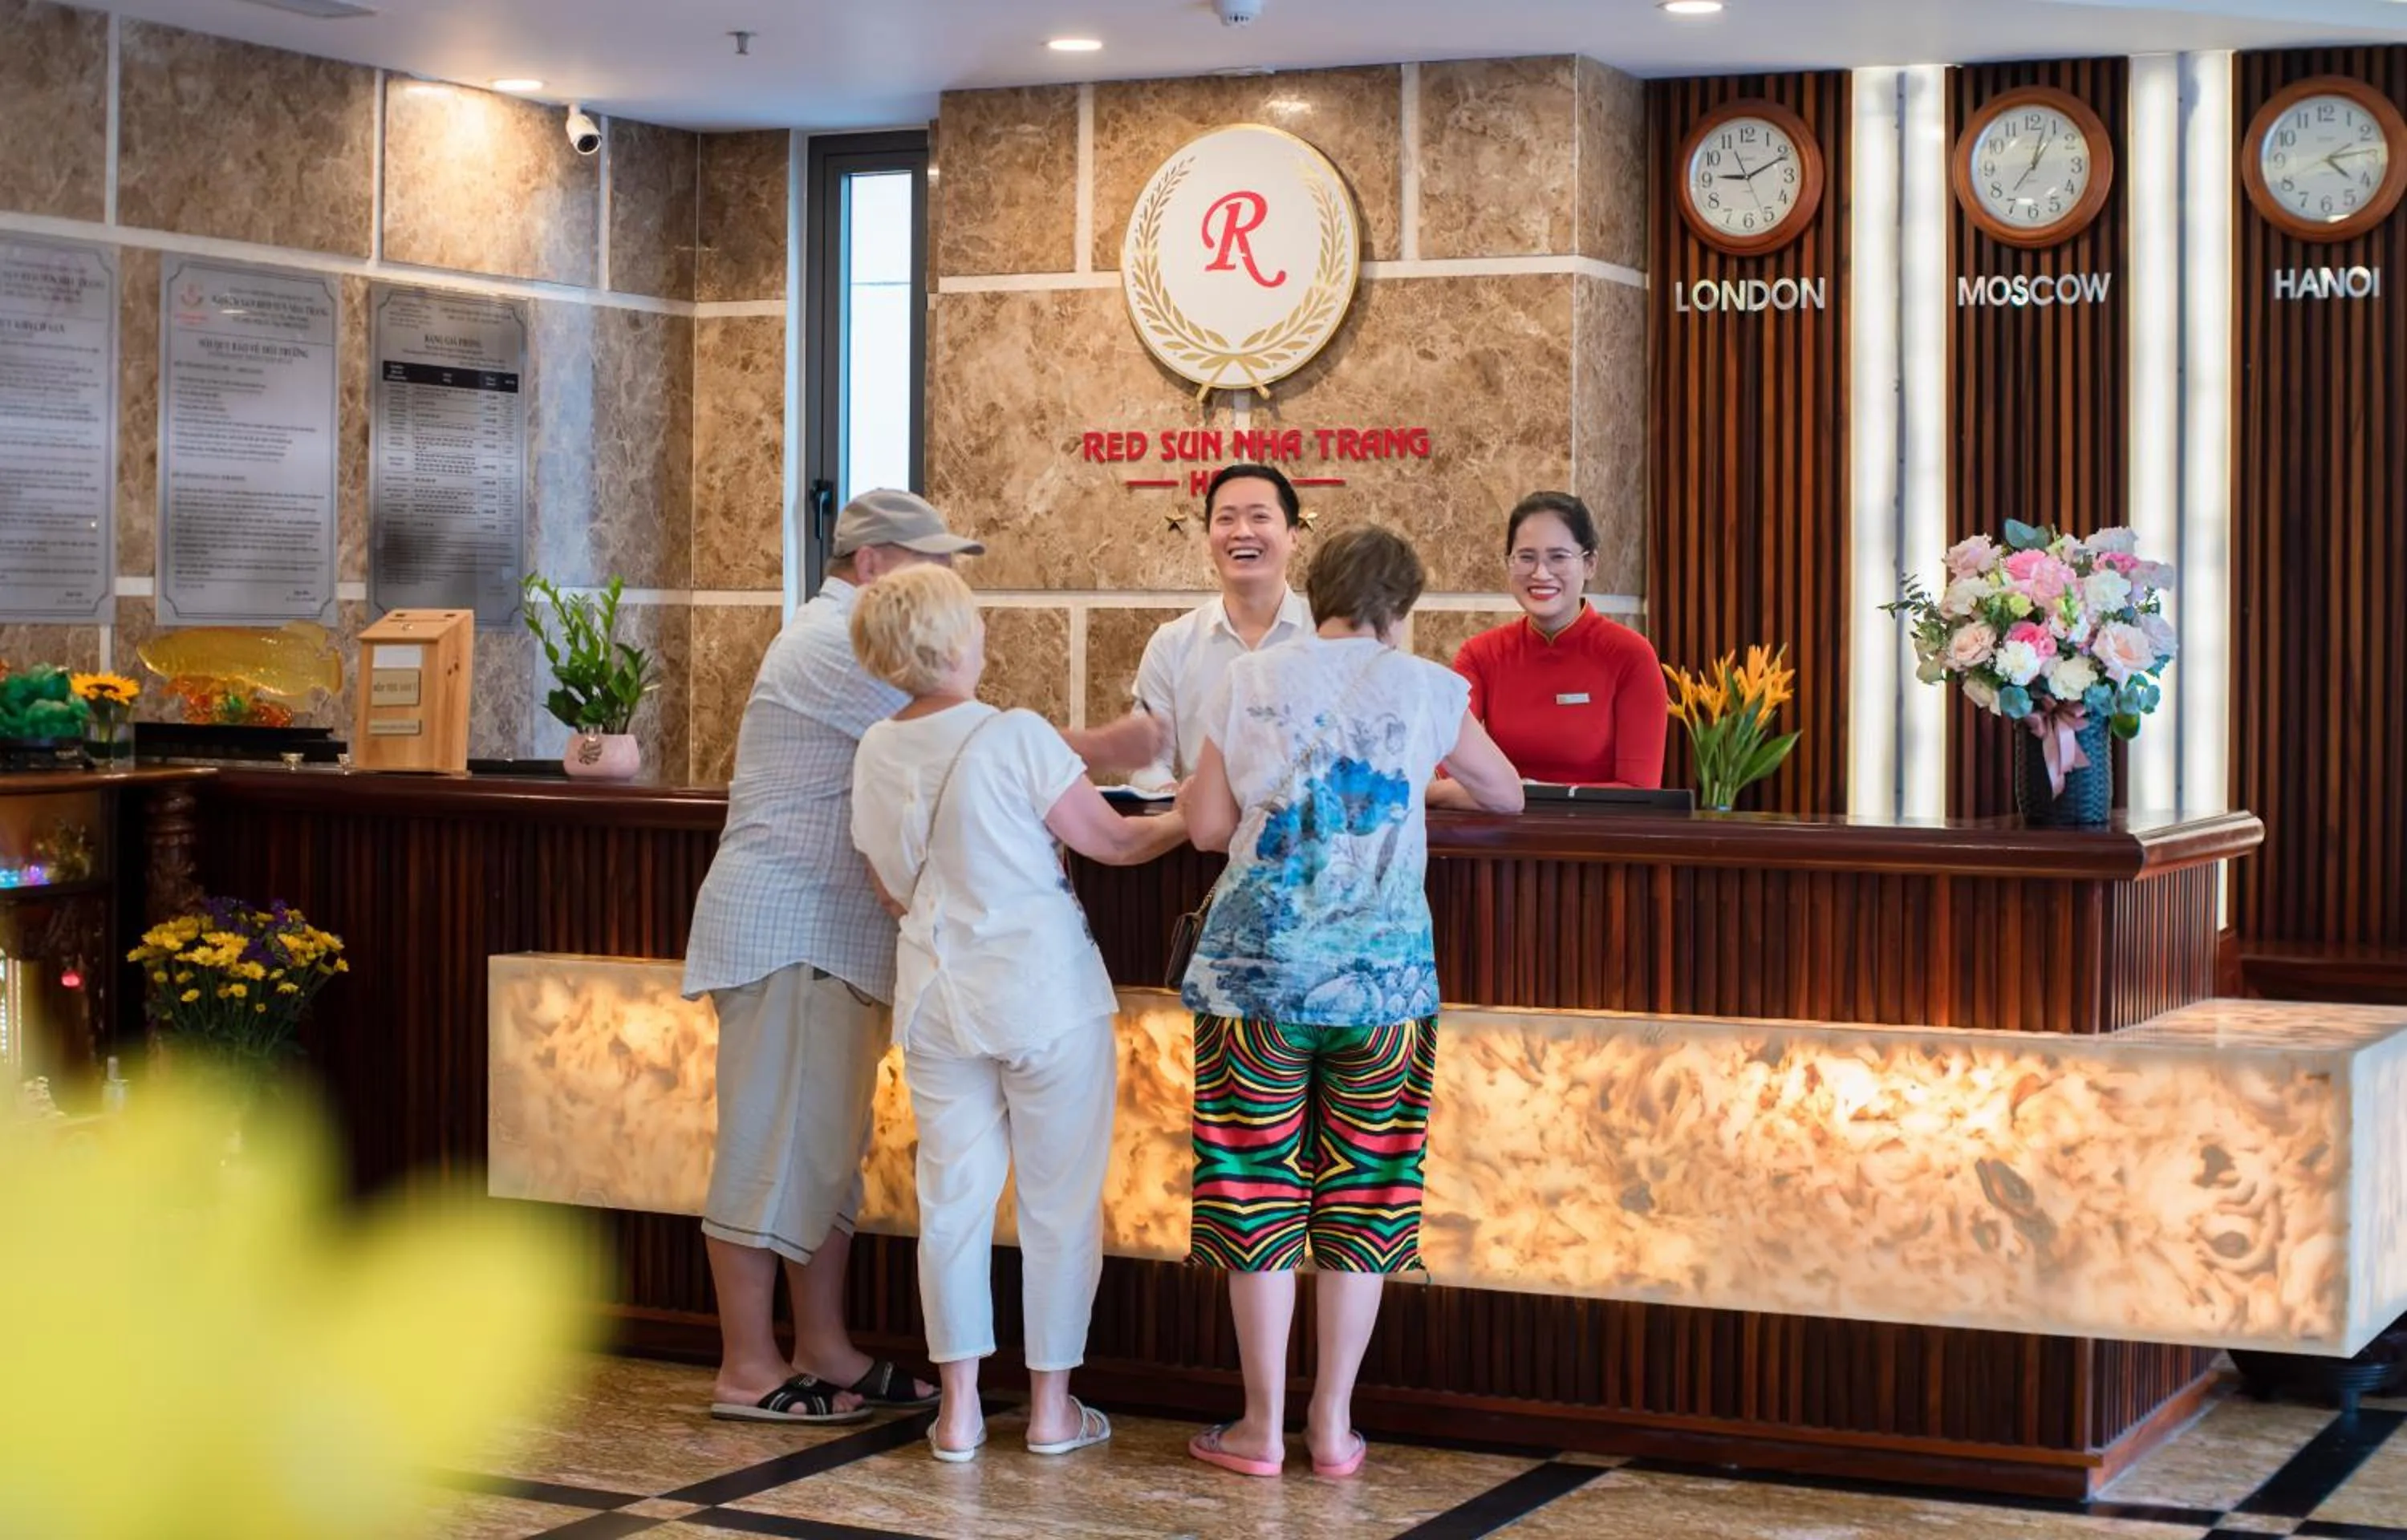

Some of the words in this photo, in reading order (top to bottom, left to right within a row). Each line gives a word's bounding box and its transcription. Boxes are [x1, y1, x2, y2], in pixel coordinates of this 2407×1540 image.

[2024, 114, 2042, 131] 12
[2297, 113, 2308, 129] 11
[2317, 105, 2336, 123] 12
[1740, 126, 1756, 144] 12
[2005, 122, 2016, 137] 11
[2359, 124, 2371, 142] 2
[1721, 134, 1732, 149] 11
[1989, 138, 2004, 154] 10
[2064, 133, 2076, 150] 2
[2279, 130, 2296, 148] 10
[1707, 149, 1720, 166] 10
[1777, 144, 1788, 160] 2
[2273, 152, 2286, 168] 9
[1983, 161, 1995, 176] 9
[2071, 156, 2082, 174] 3
[1702, 172, 1712, 188] 9
[1784, 168, 1795, 184] 3
[2280, 176, 2295, 192] 8
[2360, 171, 2371, 188] 4
[1991, 182, 2003, 198] 8
[2064, 179, 2074, 195] 4
[1708, 192, 1719, 209] 8
[1777, 189, 1788, 205] 4
[2048, 197, 2061, 213] 5
[2298, 191, 2310, 208] 7
[2320, 195, 2333, 213] 6
[2344, 189, 2356, 206] 5
[1764, 206, 1775, 222] 5
[2006, 198, 2016, 215] 7
[2027, 204, 2039, 220] 6
[1723, 209, 1733, 224] 7
[1743, 213, 1755, 229] 6
[1201, 190, 1287, 288] R
[1958, 273, 2112, 306] MOSCOW
[2275, 265, 2381, 299] HANOI
[1675, 277, 1826, 312] LONDON
[1082, 431, 1149, 464] RED
[1160, 430, 1224, 462] SUN
[1233, 428, 1302, 462] NHA
[1315, 428, 1431, 461] TRANG
